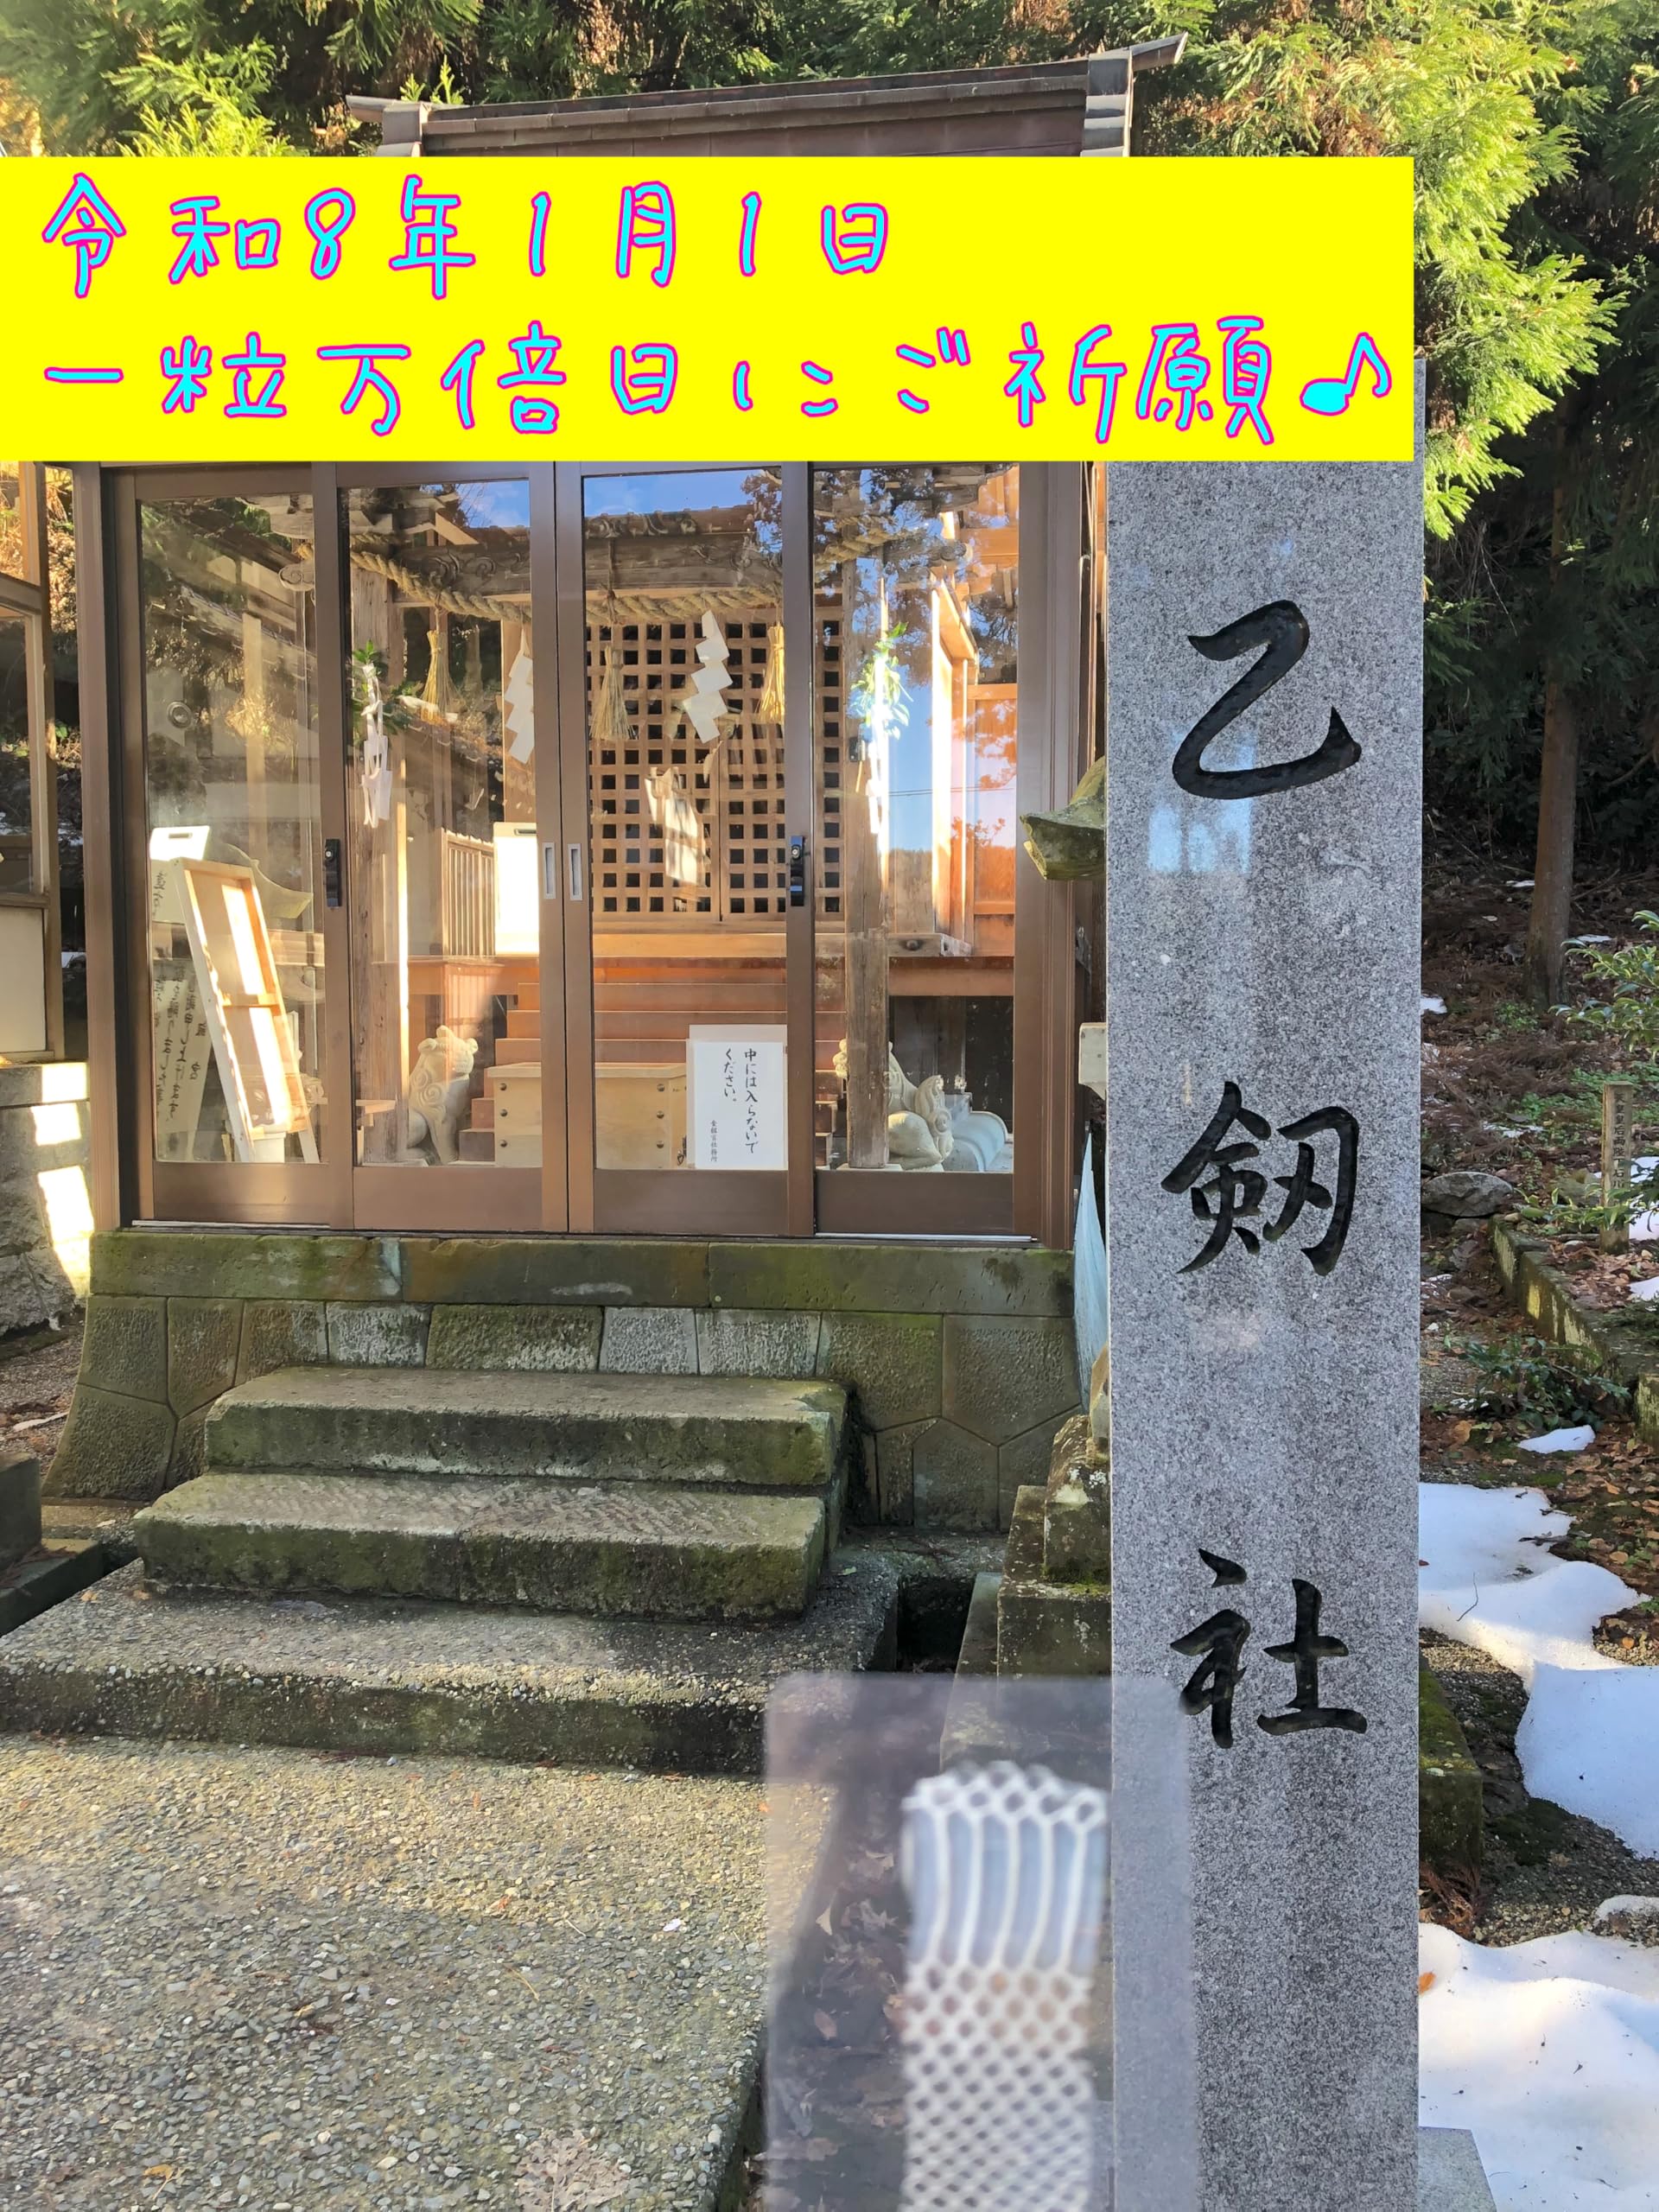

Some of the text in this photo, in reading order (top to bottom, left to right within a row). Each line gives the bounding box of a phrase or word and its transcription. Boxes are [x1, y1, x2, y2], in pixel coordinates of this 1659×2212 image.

[723, 1048, 736, 1102] ください。
[744, 1048, 758, 1154] 中には入らないで
